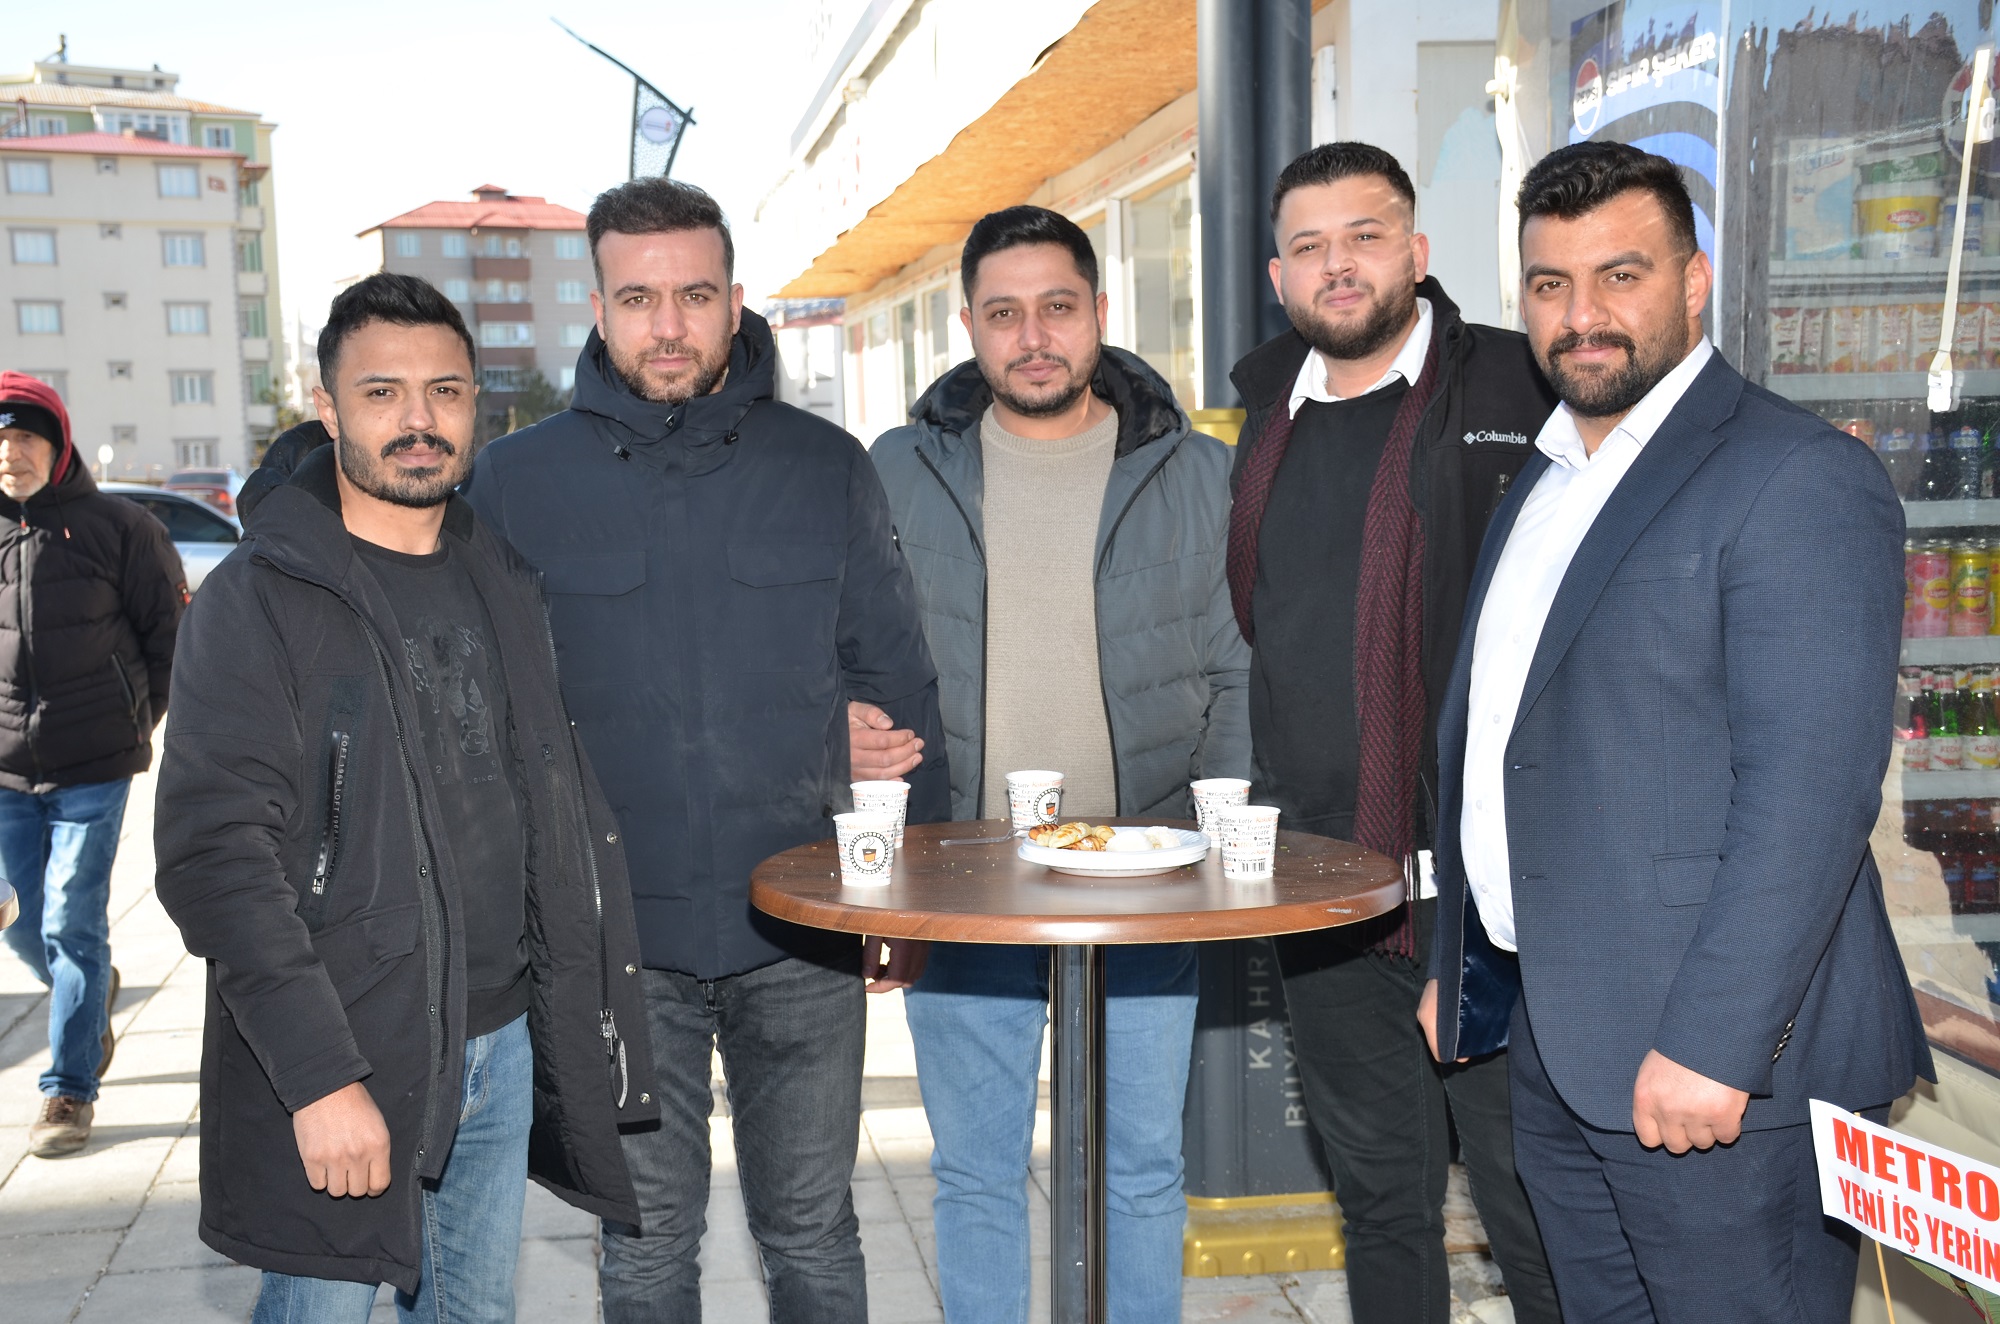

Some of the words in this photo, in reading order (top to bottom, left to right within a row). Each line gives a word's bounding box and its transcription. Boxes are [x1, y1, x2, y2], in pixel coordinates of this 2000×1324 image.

[1476, 430, 1528, 444] Columbia
[340, 733, 350, 760] LOFT
[336, 763, 345, 786] 1968
[333, 788, 342, 812] LOFT
[1832, 1117, 2000, 1222] METRO
[1837, 1175, 1887, 1235] YENİ
[1893, 1194, 1920, 1253] İŞ
